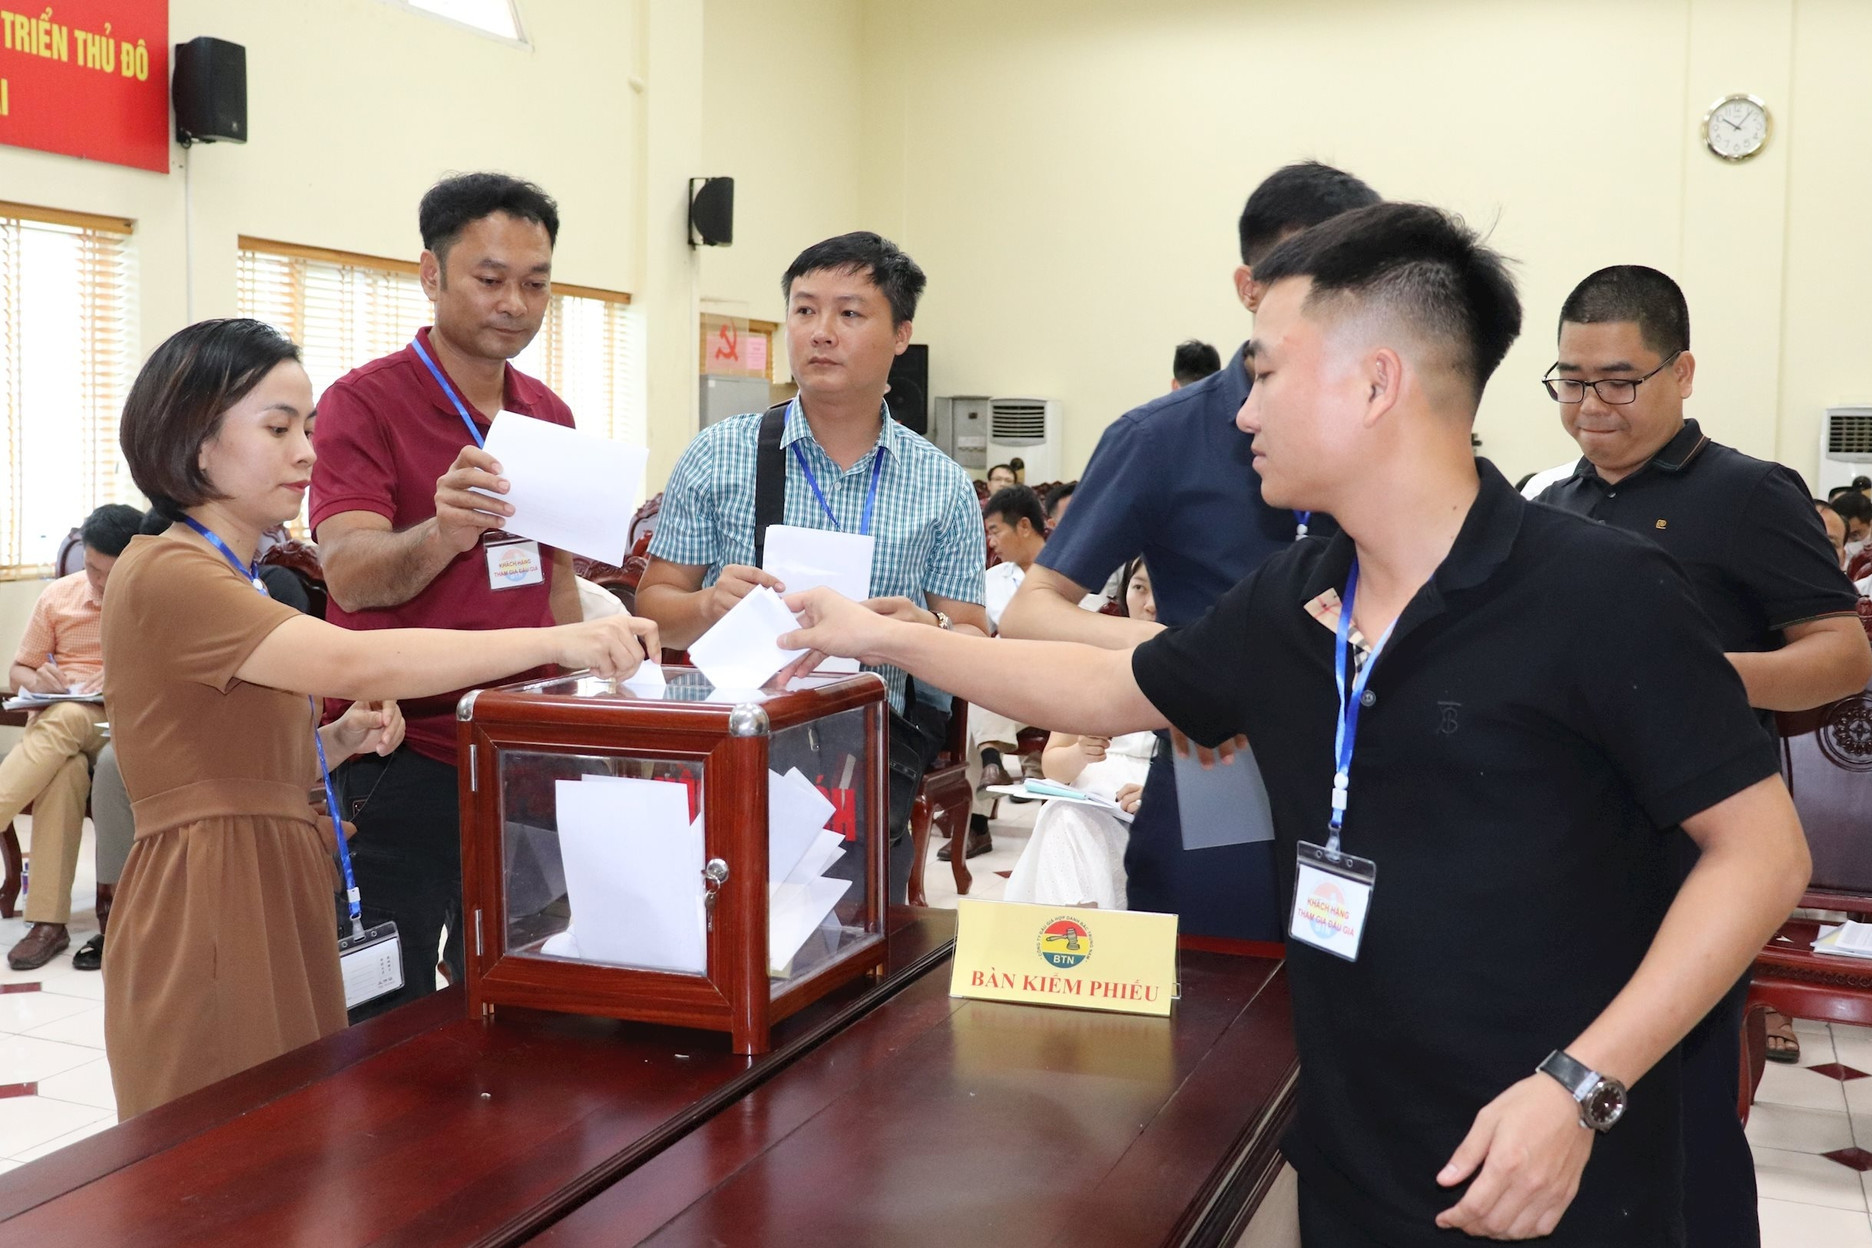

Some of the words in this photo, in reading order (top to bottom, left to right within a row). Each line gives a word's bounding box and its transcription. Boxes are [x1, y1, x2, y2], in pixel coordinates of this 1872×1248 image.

[0, 6, 68, 63] TRIỂN
[74, 22, 115, 73] THỦ
[120, 38, 149, 81] ĐÔ
[1298, 908, 1314, 921] THAM
[1053, 954, 1075, 965] BTN
[971, 966, 1016, 989] BÀN
